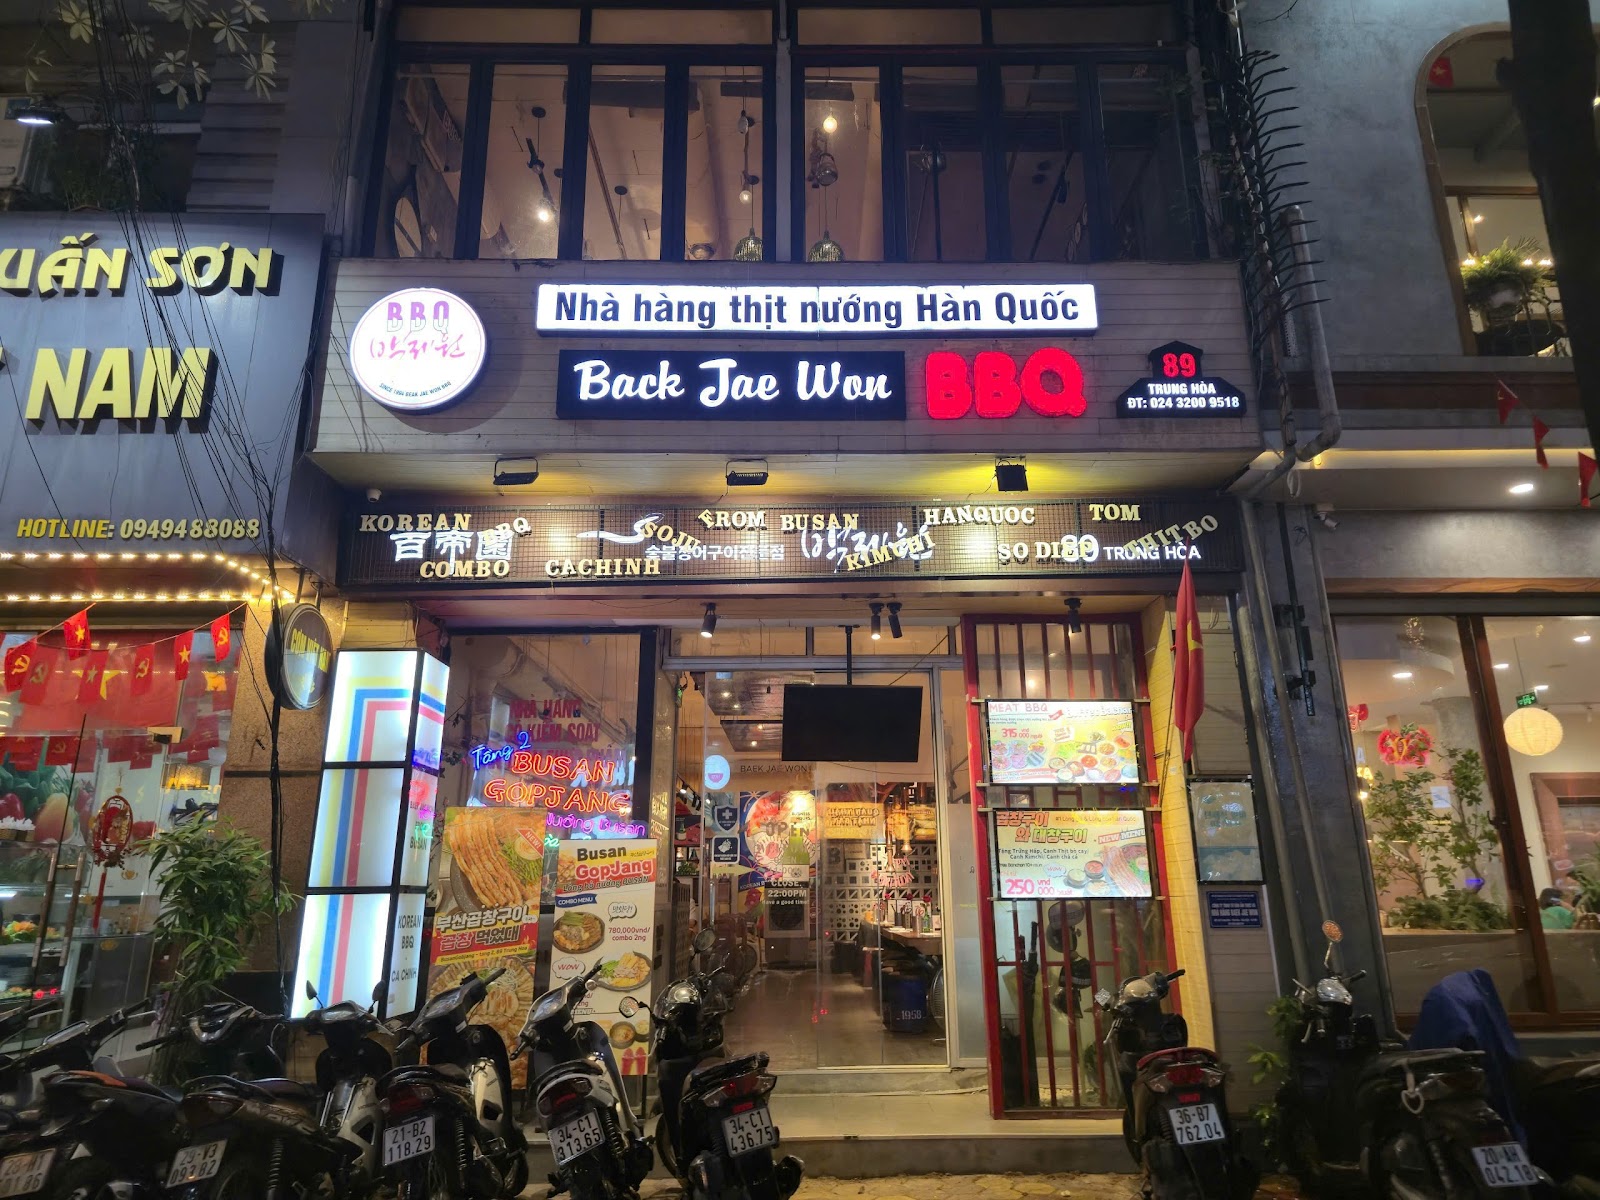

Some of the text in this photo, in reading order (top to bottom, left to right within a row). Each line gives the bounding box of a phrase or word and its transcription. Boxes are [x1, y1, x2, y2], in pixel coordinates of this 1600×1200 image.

[147, 241, 273, 289] SƠN
[386, 300, 450, 334] BBQ
[555, 289, 1079, 330] Nhà hàng thịt nướng Hàn Quốc
[1162, 352, 1196, 378] 89
[25, 347, 213, 419] NAM
[573, 357, 892, 408] Back Jae Won
[925, 347, 1087, 420] BBQ
[1148, 380, 1216, 395] TRUNG HÒA
[1126, 396, 1240, 409] ĐT: 024 3200 9518
[360, 513, 472, 532] KOREAN
[780, 514, 858, 531] BUSAN
[1088, 504, 1141, 522] TOM
[16, 518, 260, 540] HOTLINE: 0949488088
[643, 521, 702, 554] SOJU
[1123, 514, 1219, 559] THIT BO
[845, 530, 936, 572] KIMCHI
[998, 542, 1028, 560] SO
[1060, 534, 1099, 562] 89
[1102, 546, 1160, 561] TRUNG
[420, 560, 510, 579] COMBO
[989, 702, 1048, 713] MEAT BBQ
[518, 731, 532, 750] 2
[512, 752, 615, 784] BUSAN
[740, 765, 763, 773] BAEK
[784, 765, 808, 773] WON
[484, 778, 631, 816] GOPJANG
[598, 818, 646, 836] Busan
[766, 822, 810, 837] OPEN
[524, 829, 542, 850] NEW!
[1098, 833, 1121, 844] NEW
[577, 846, 626, 862] Busan
[576, 860, 652, 880] GopJang
[768, 889, 807, 898] 22:00PM
[1004, 878, 1035, 894] 250
[1038, 886, 1054, 896] 000
[558, 898, 578, 906] COMBO
[398, 914, 422, 928] KOREAN
[437, 905, 528, 932] 부산곱창구이
[608, 926, 651, 934] 780,000vnd/
[401, 936, 414, 950] BBQ
[391, 967, 417, 982] CA CHINH
[901, 1010, 922, 1020] 1958
[730, 1110, 764, 1135] 34-C1
[1176, 1105, 1210, 1125] 36-B7
[392, 1120, 426, 1144] 21-B2
[558, 1114, 592, 1143] 34-C1
[1176, 1122, 1222, 1144] 762.04
[389, 1135, 431, 1162] 118.29
[558, 1128, 601, 1162] 313.65
[730, 1126, 774, 1152] 436.75
